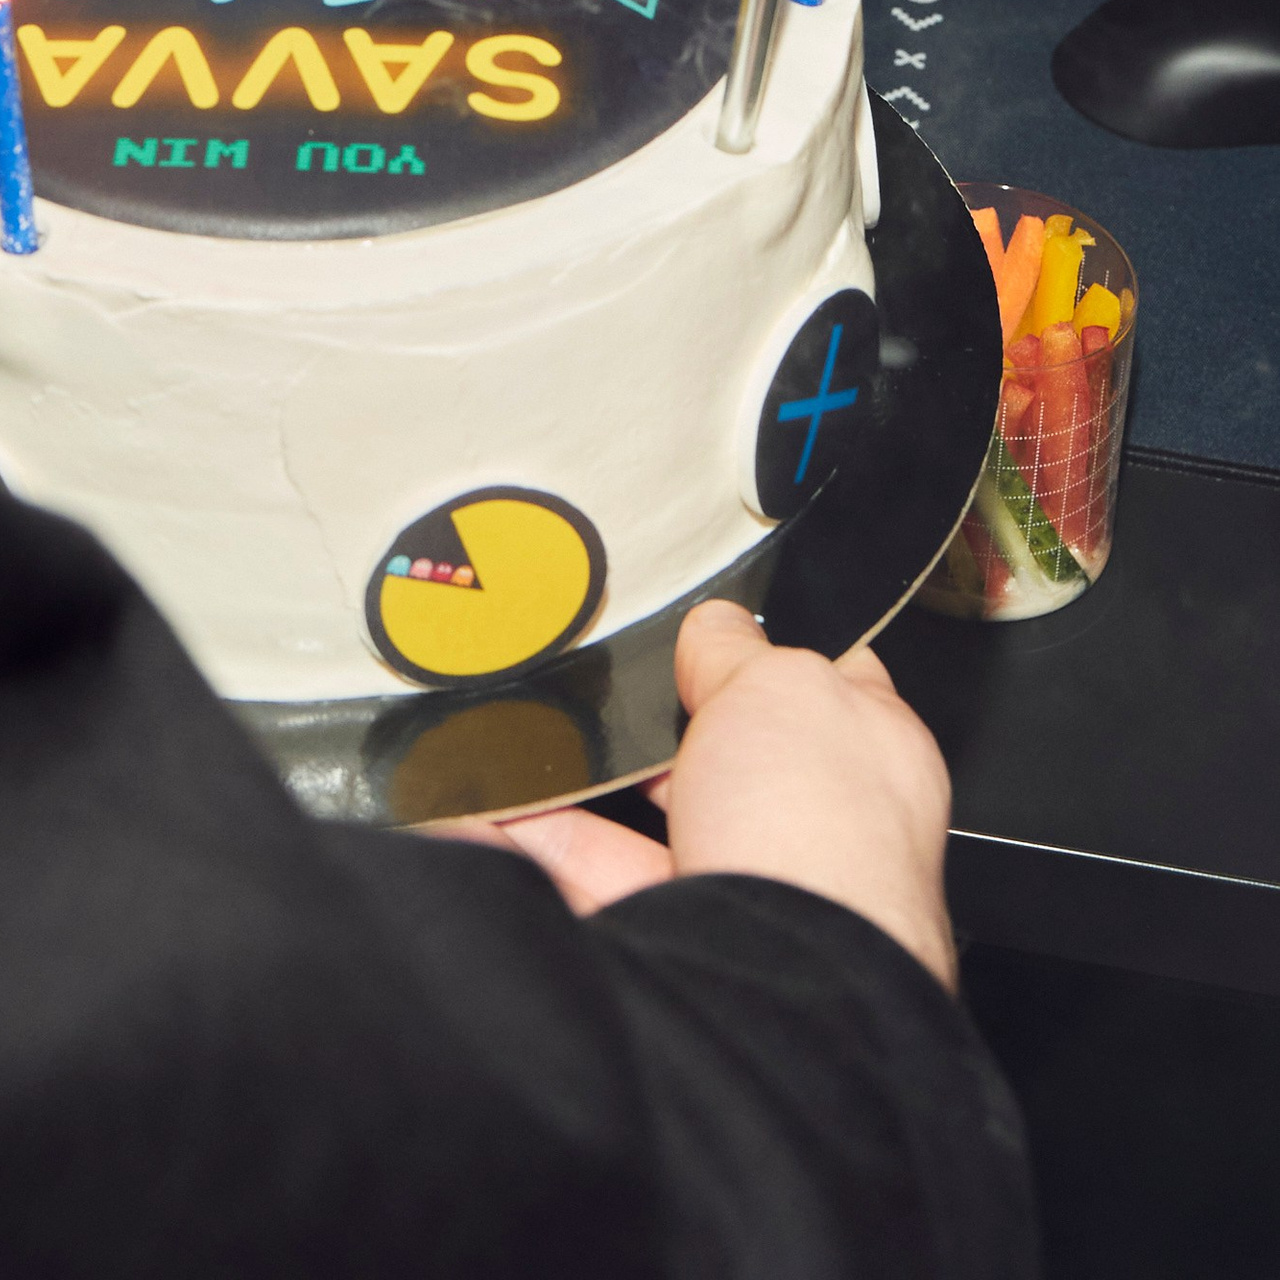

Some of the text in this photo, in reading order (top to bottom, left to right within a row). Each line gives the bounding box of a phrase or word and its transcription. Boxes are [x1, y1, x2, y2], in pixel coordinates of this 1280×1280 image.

[16, 23, 564, 122] SAVVA
[112, 137, 427, 176] YOU WIN
